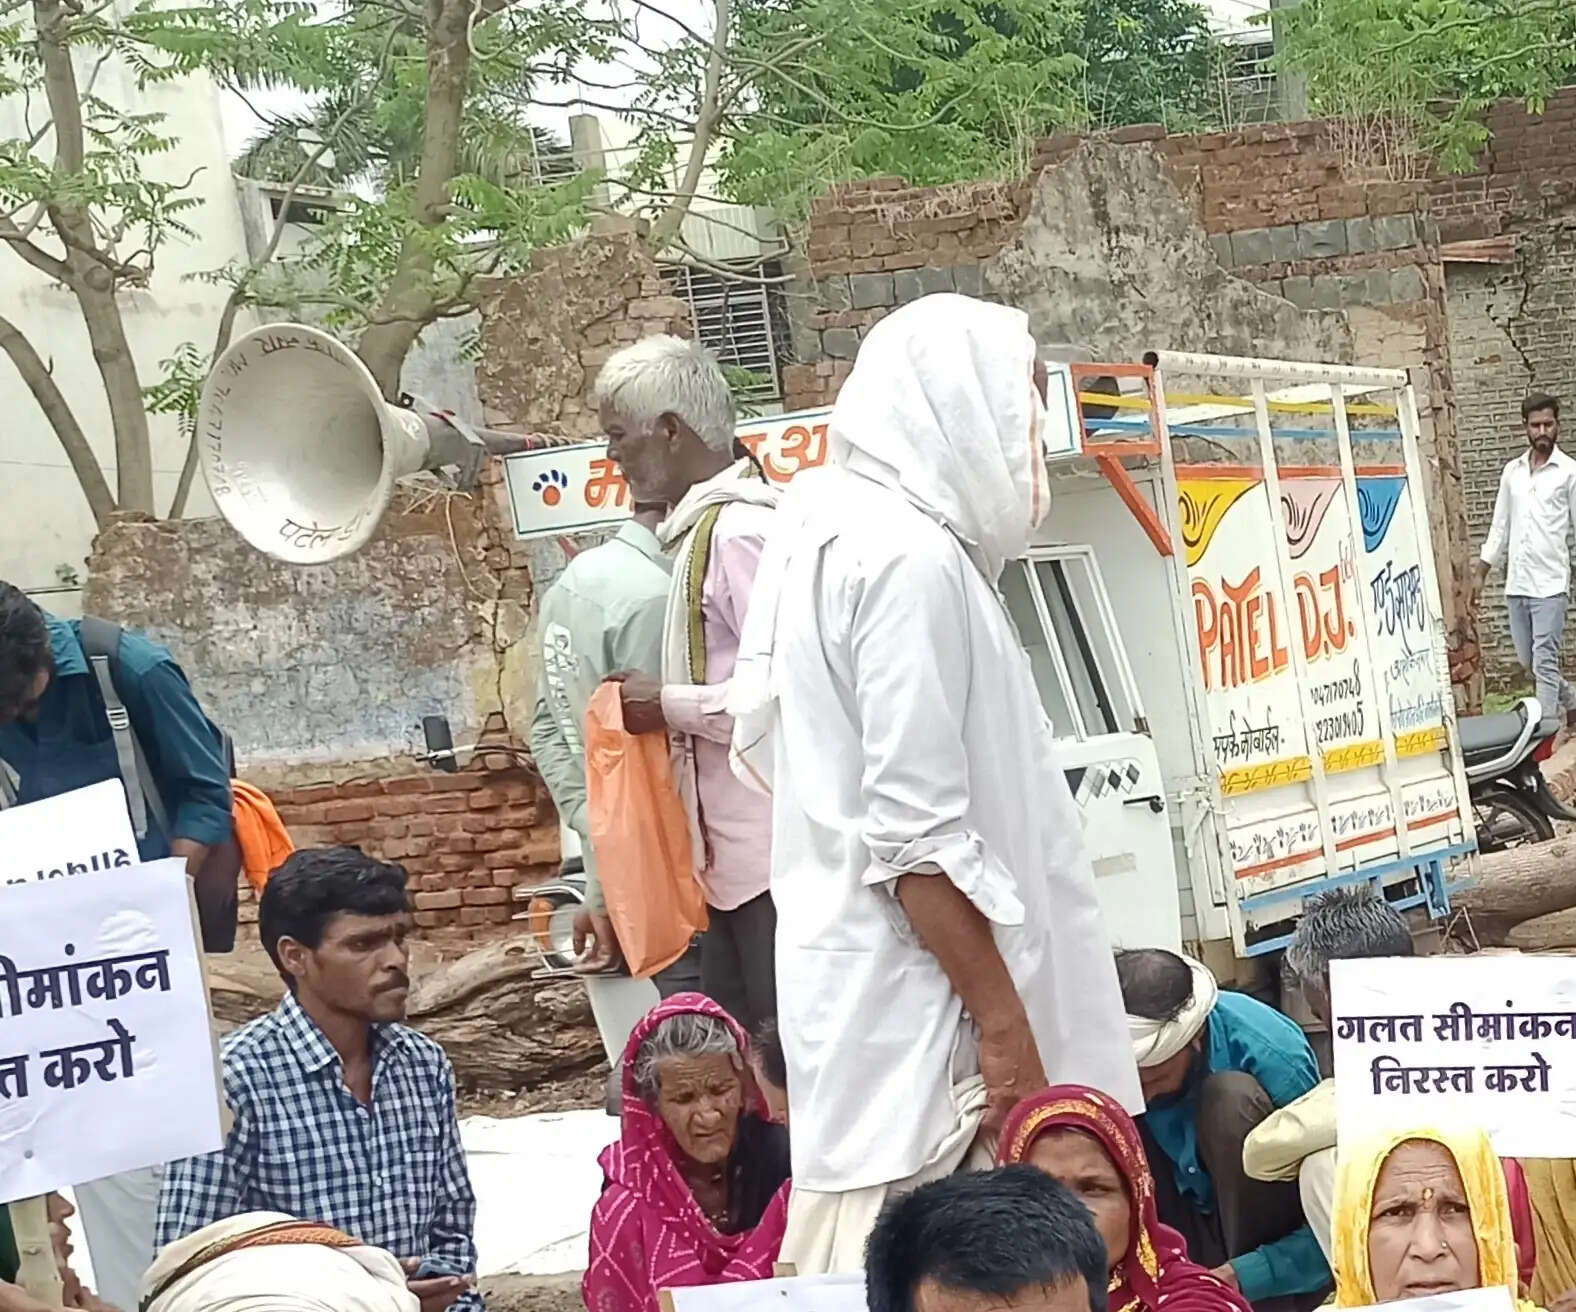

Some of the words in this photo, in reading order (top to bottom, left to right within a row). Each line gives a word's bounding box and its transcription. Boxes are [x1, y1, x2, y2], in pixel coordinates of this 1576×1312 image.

[1191, 565, 1289, 692] PATEL
[0, 942, 171, 1019] ीमांकन
[39, 1018, 137, 1090] करो
[1337, 1014, 1424, 1043] गलत
[1370, 1055, 1475, 1095] निरस्त
[1484, 1052, 1552, 1093] करो
